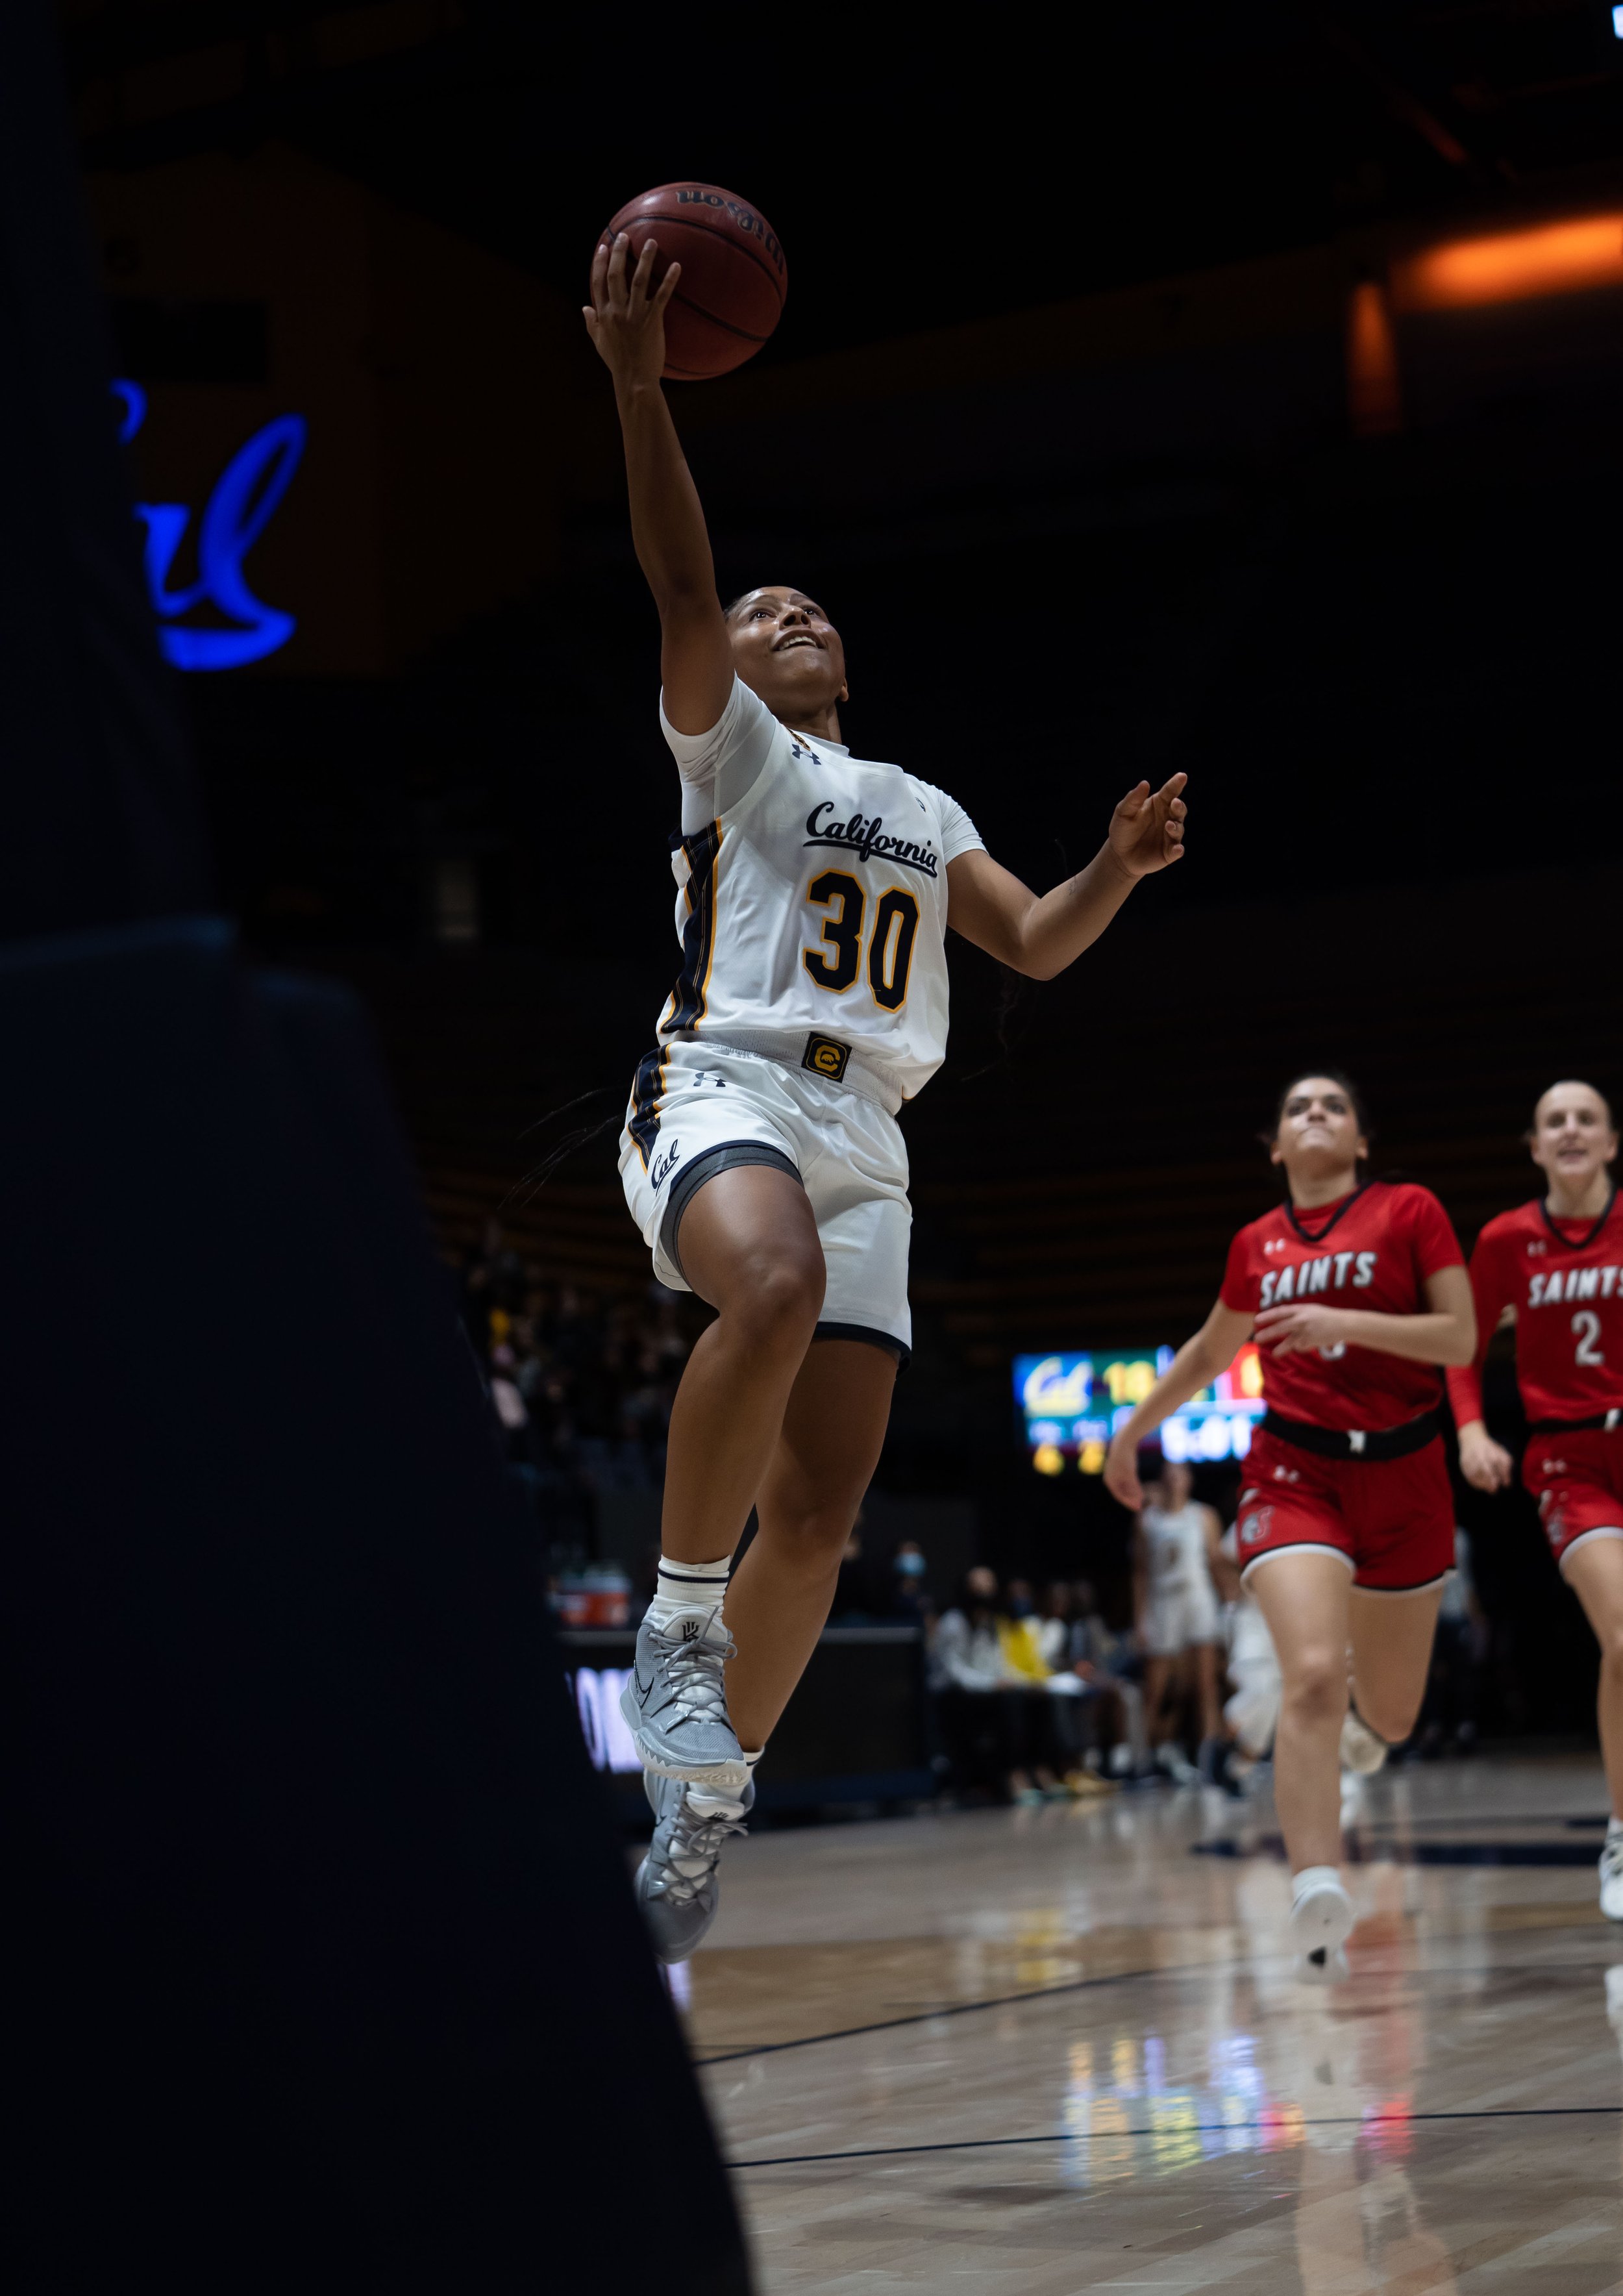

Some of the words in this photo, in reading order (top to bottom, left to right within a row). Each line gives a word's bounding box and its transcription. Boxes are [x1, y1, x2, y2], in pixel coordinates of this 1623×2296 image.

[803, 801, 937, 878] California
[803, 867, 921, 1014] 30
[651, 1138, 680, 1197] Cal
[1259, 1251, 1377, 1310] SAINTS
[1571, 1310, 1605, 1367] 2
